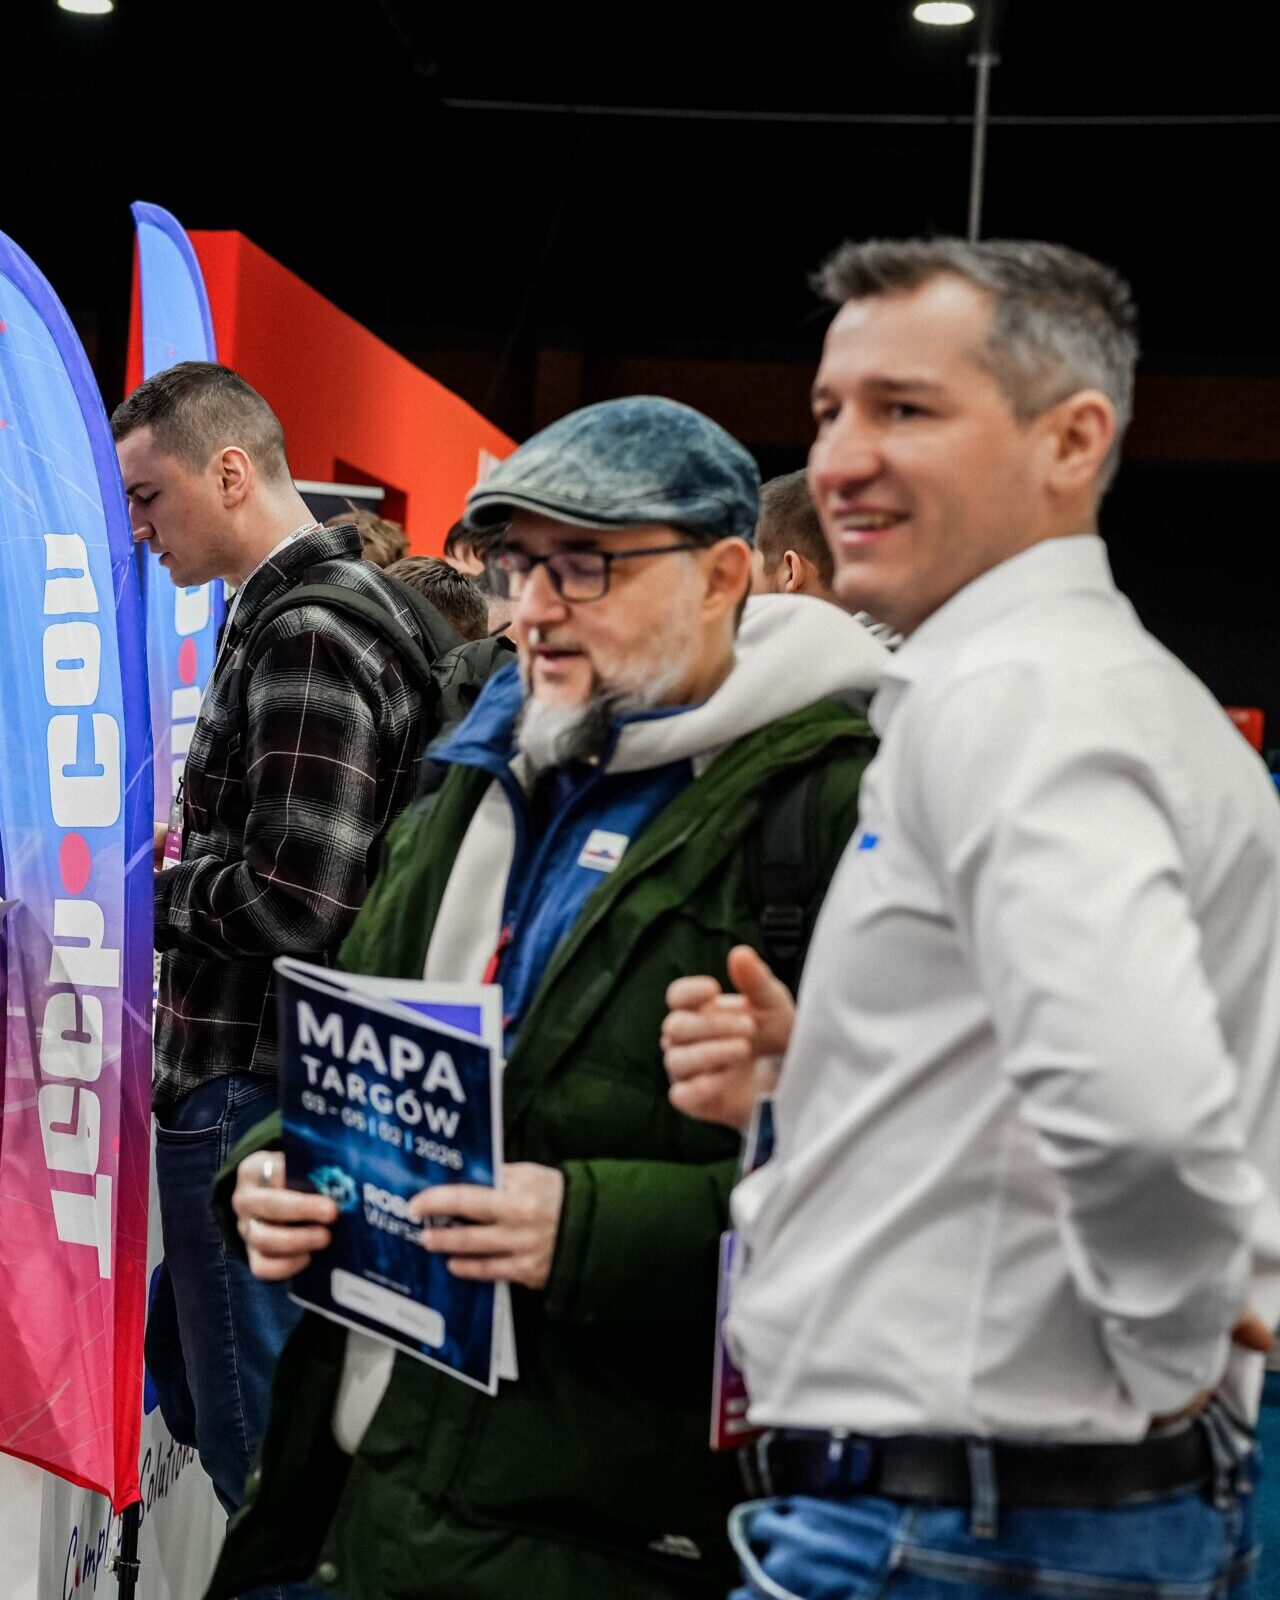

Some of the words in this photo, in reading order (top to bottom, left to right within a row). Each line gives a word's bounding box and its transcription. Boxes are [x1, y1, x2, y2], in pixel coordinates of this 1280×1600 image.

[297, 1000, 466, 1103] MAPA
[300, 1054, 460, 1138] TARGÓW
[363, 1203, 426, 1247] Warsa
